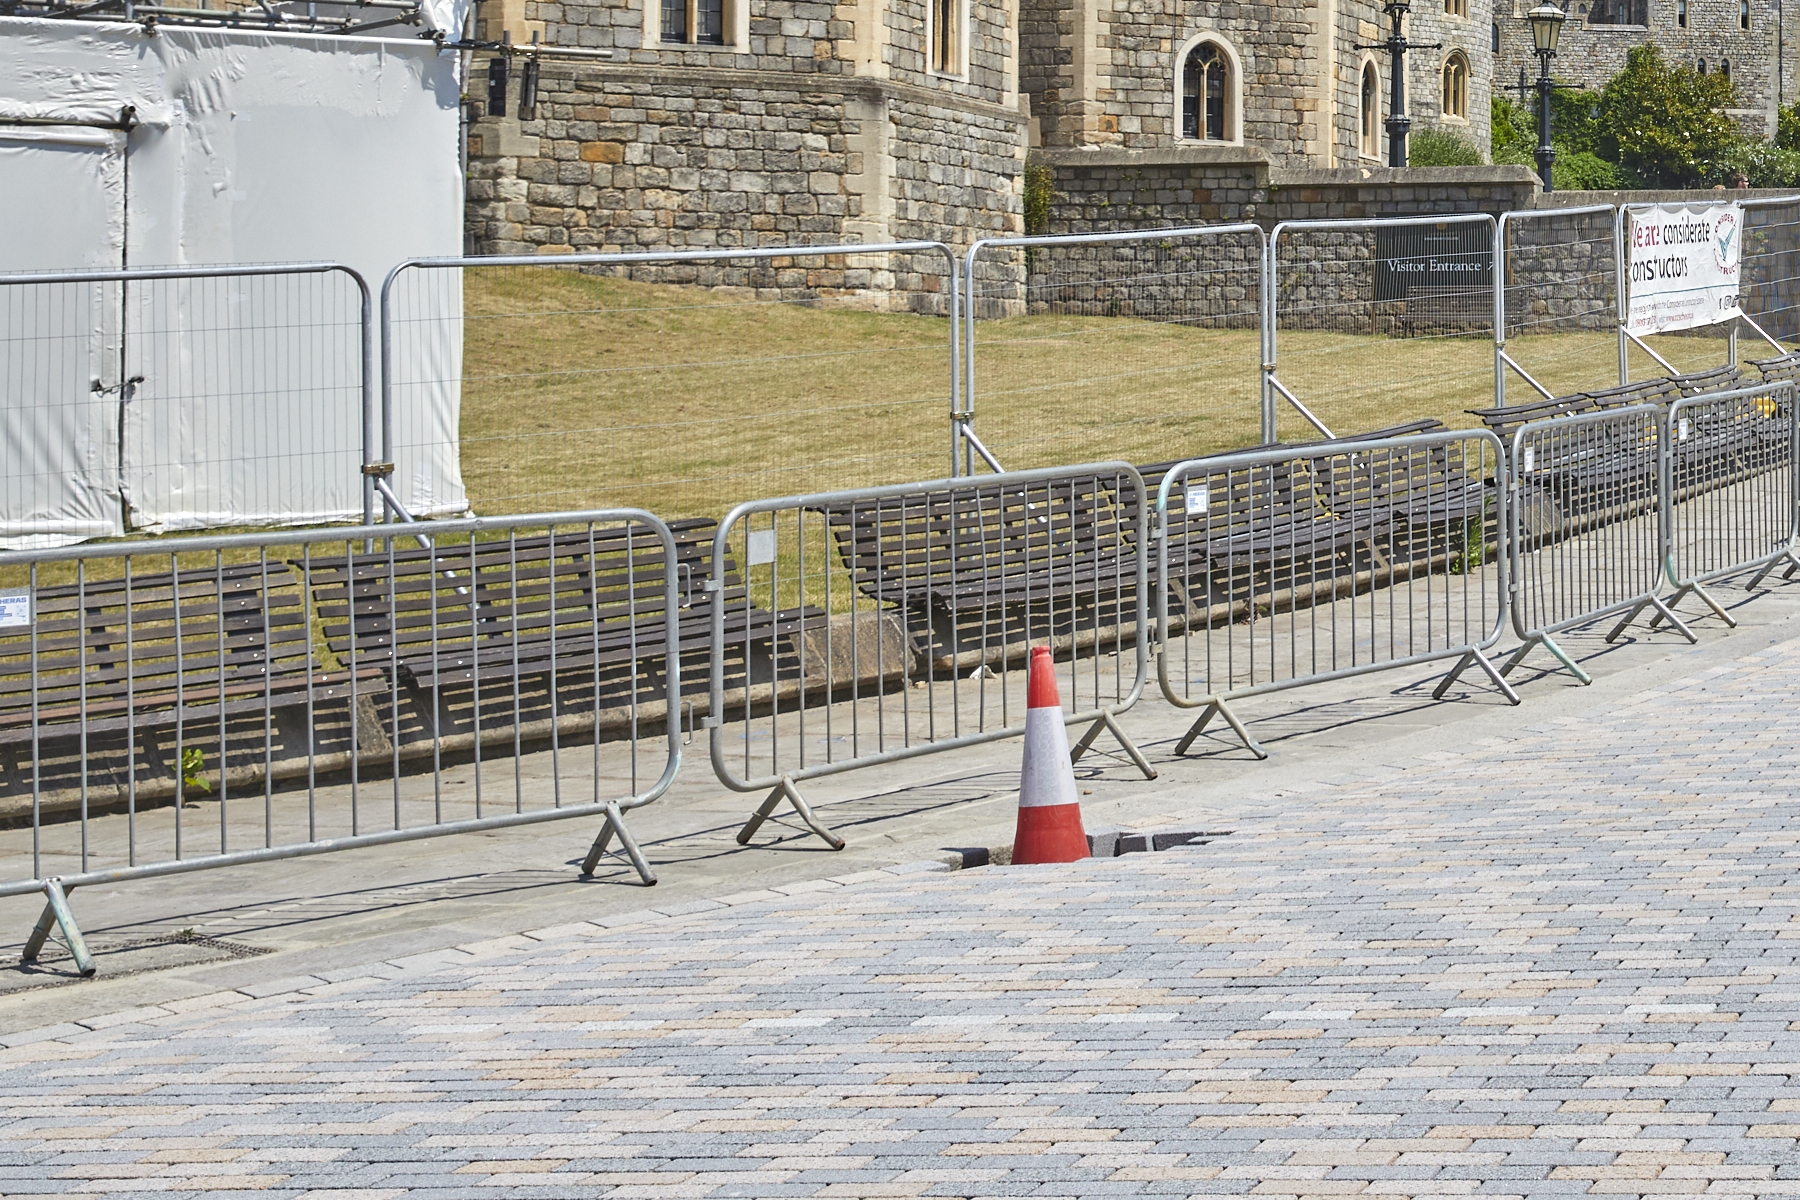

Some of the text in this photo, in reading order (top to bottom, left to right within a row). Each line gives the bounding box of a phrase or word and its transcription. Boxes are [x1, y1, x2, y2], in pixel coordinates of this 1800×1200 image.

[1663, 215, 1710, 245] considerate
[1387, 259, 1481, 272] Visitor Entrance
